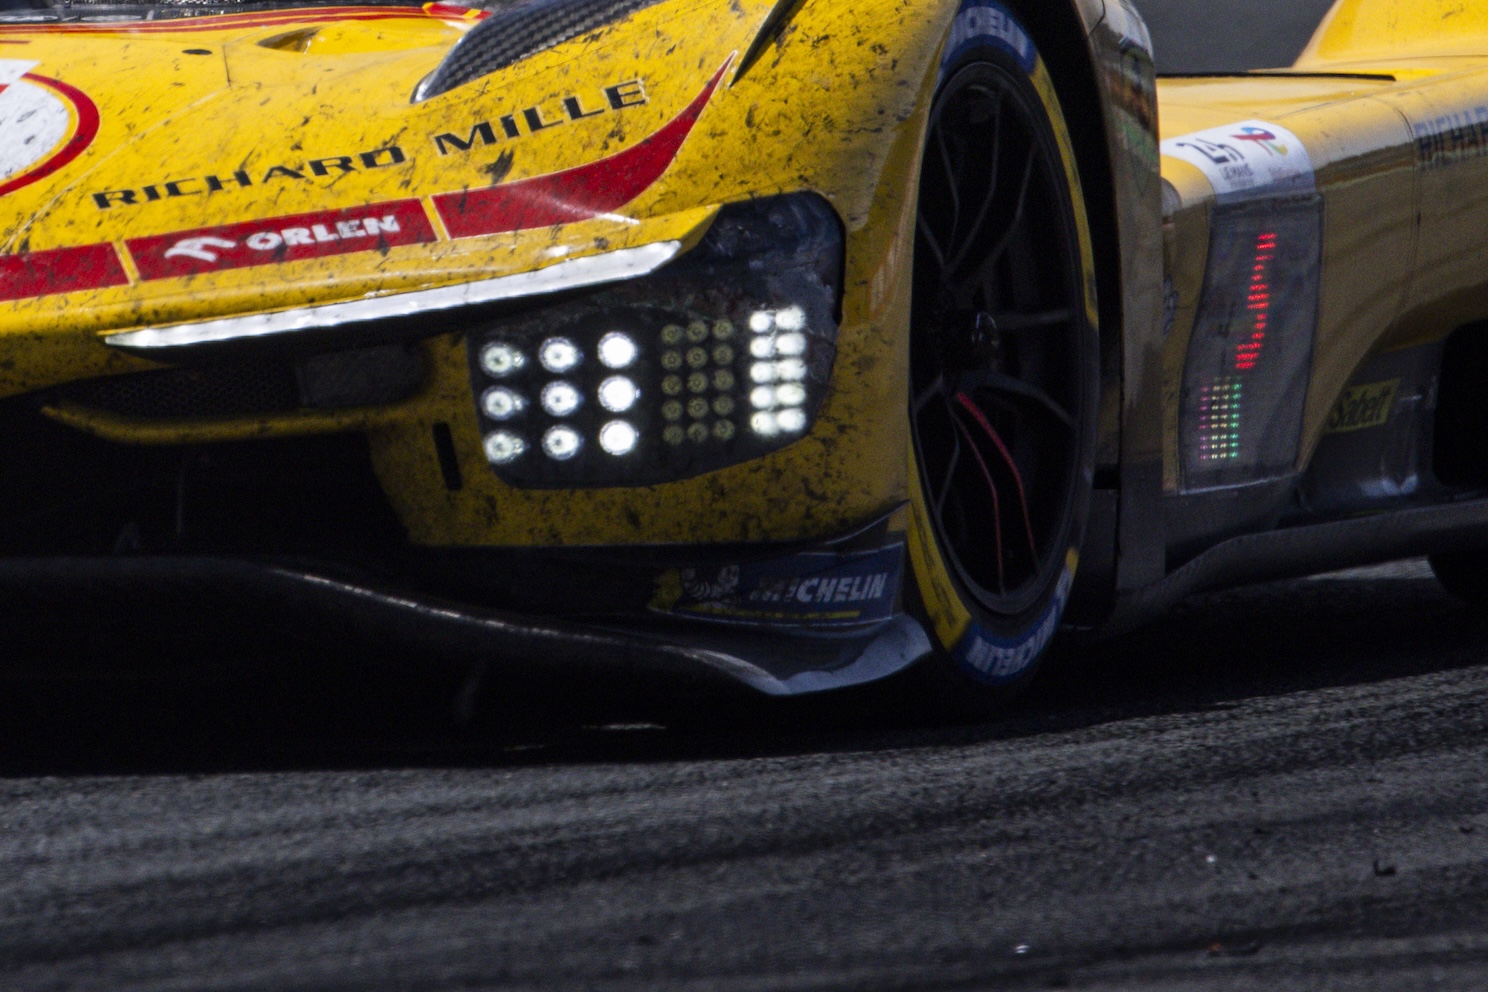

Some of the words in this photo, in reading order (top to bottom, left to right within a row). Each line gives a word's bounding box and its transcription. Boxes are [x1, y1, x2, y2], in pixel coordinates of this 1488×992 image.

[93, 146, 409, 210] RICHARD
[434, 78, 651, 157] MILLE
[246, 215, 401, 252] ORLEN
